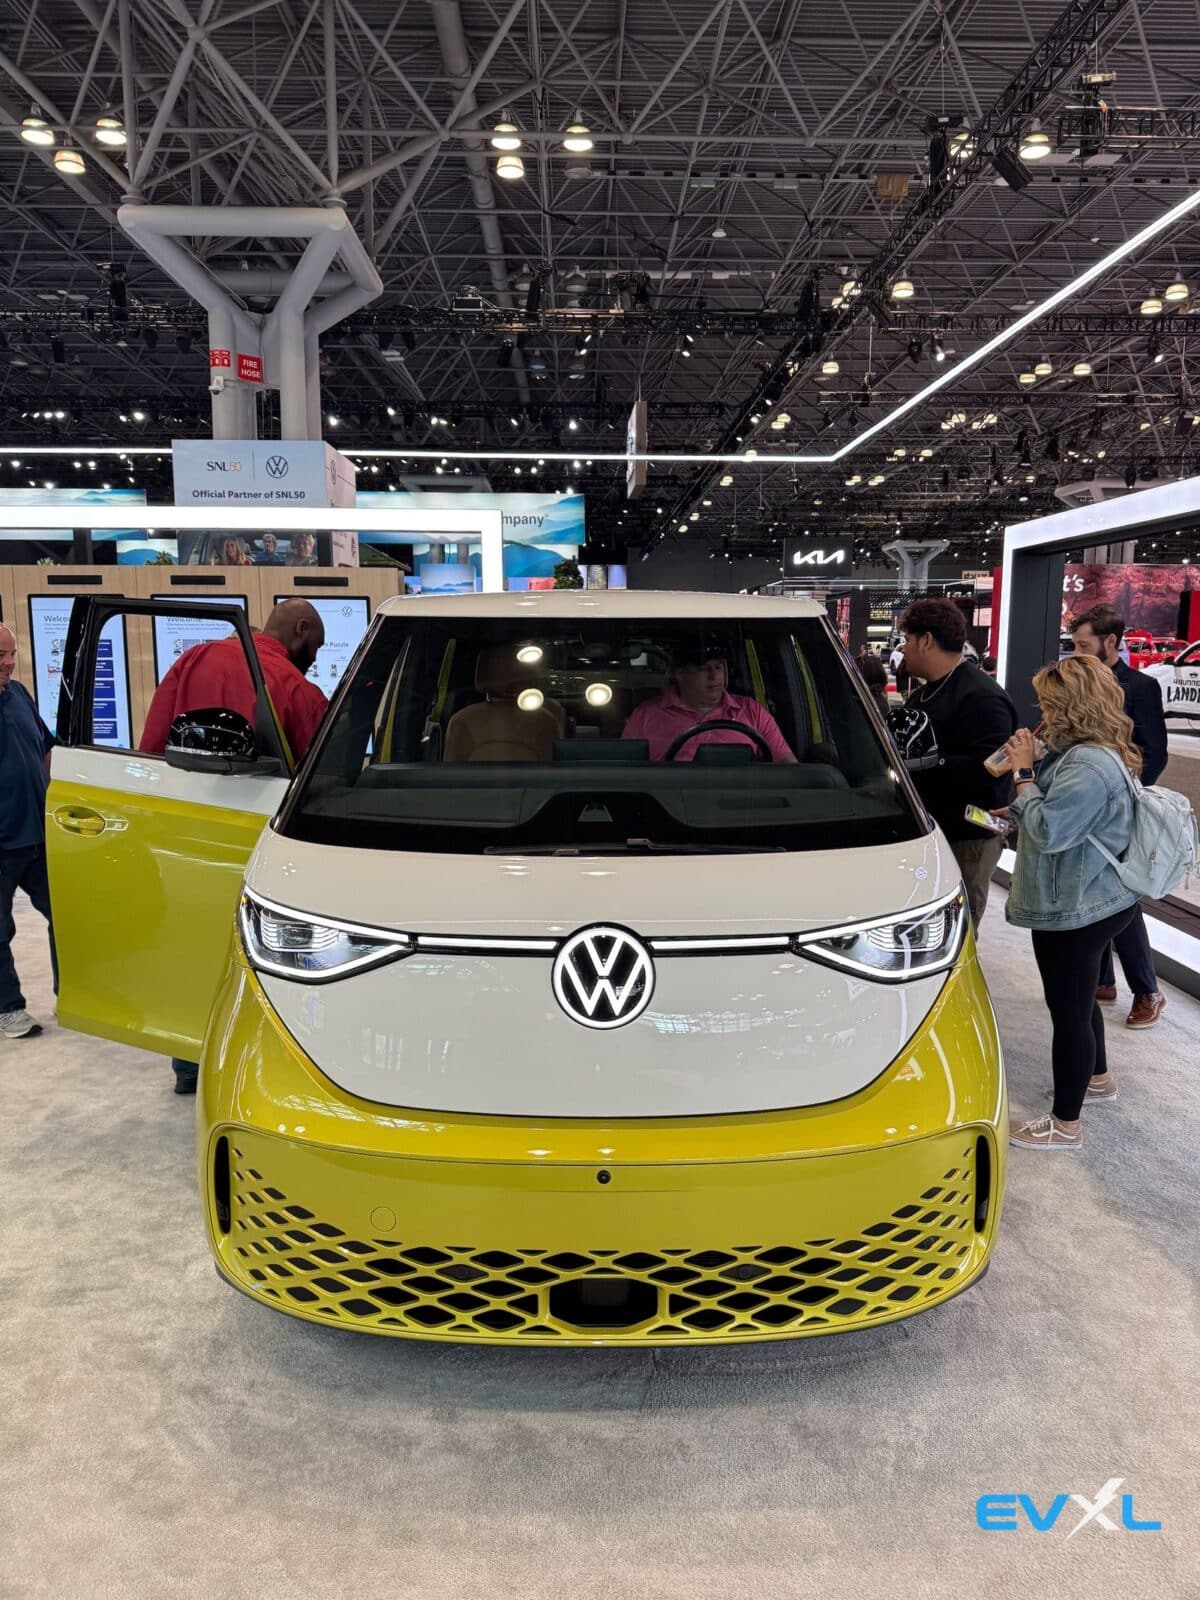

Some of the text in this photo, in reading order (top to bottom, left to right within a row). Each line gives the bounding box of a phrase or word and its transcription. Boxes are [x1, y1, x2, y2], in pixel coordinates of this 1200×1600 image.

[243, 359, 258, 368] FIRE
[241, 368, 261, 378] HOSE
[192, 489, 305, 499] Official Partner of SNL50
[793, 550, 845, 565] KIA
[43, 615, 69, 623] Welco
